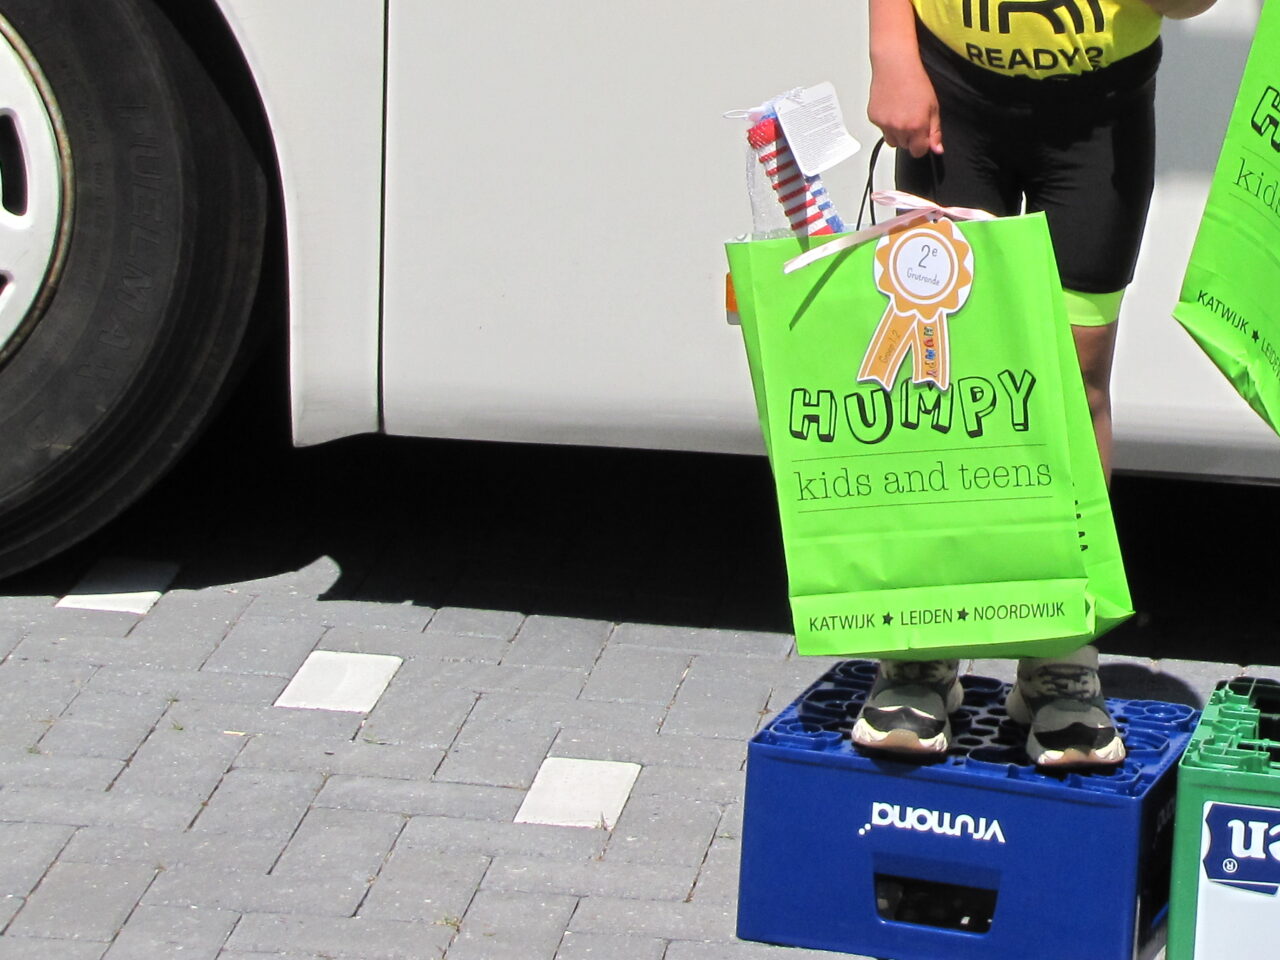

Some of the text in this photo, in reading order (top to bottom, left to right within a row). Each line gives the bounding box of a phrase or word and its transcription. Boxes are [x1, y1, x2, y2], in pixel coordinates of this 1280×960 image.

[965, 42, 1081, 72] READY
[1197, 289, 1249, 335] KATWIJK
[788, 368, 1037, 445] HUMPY
[794, 460, 1053, 502] kids and teens
[808, 601, 1065, 632] KATWIJK LEIDEN NOORDWIJK
[870, 801, 1007, 844] vrumona
